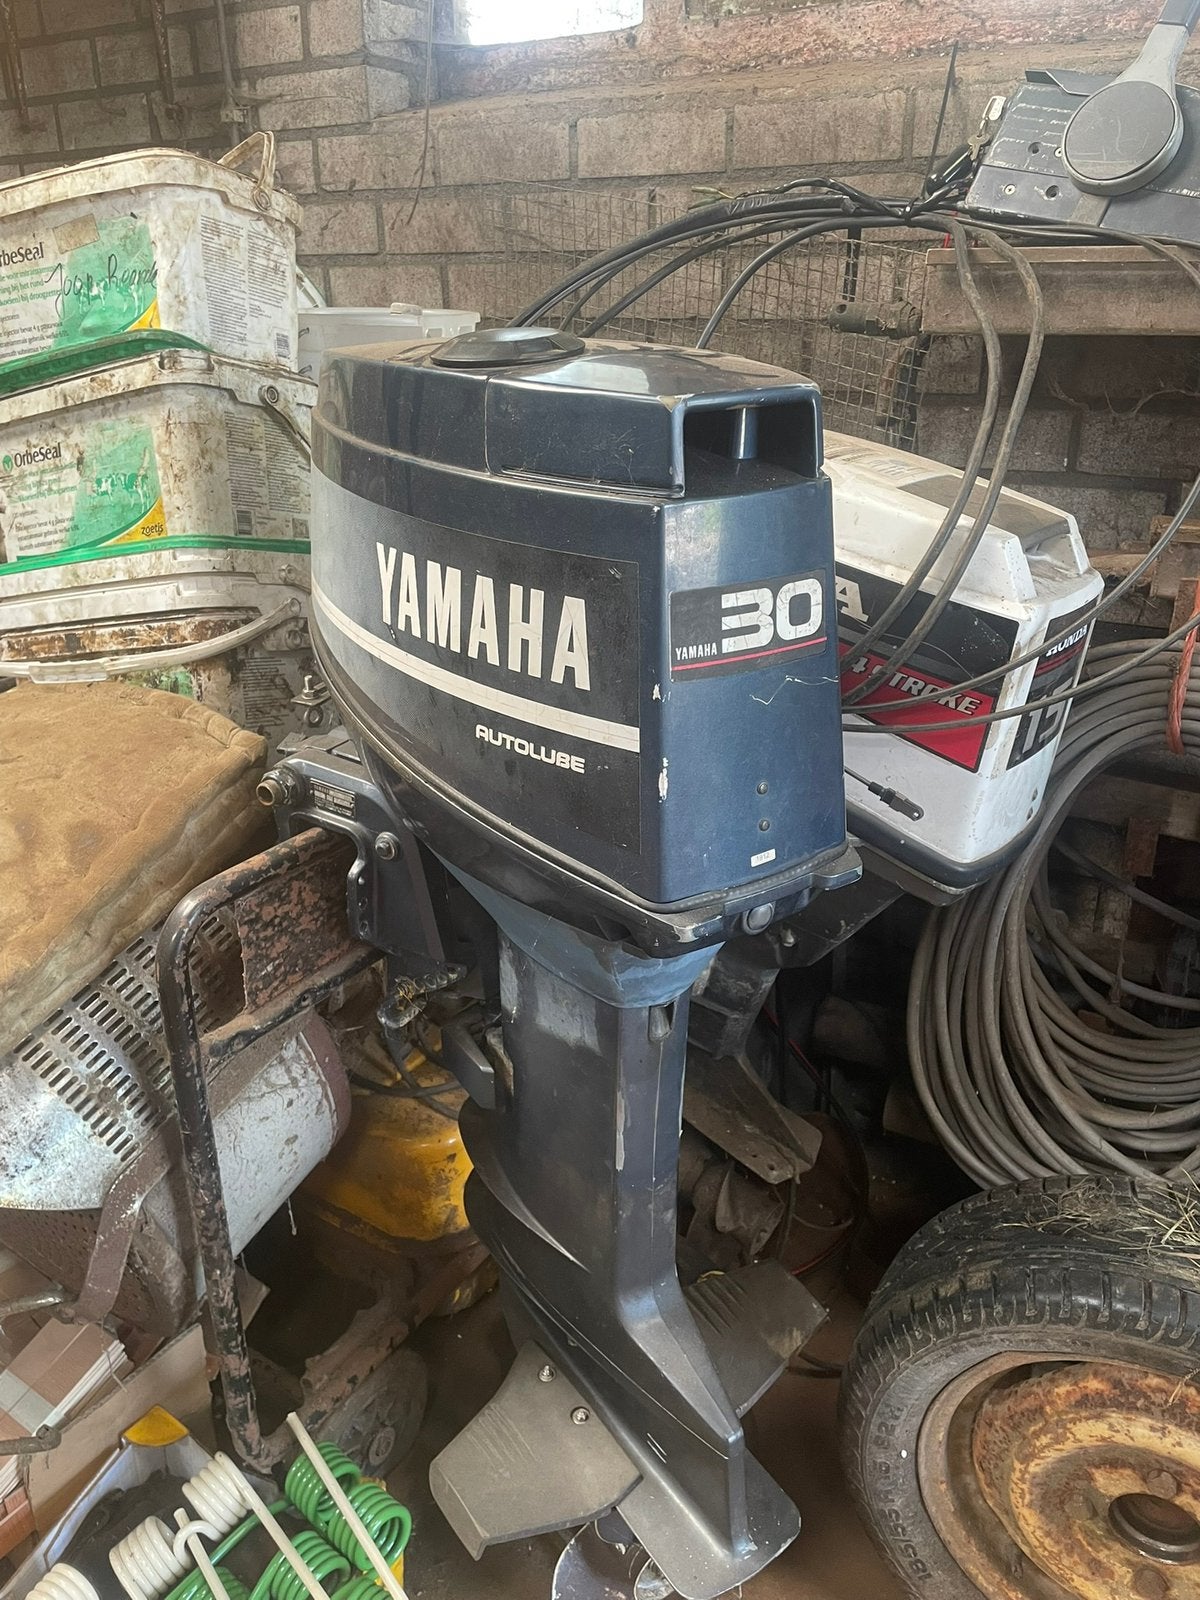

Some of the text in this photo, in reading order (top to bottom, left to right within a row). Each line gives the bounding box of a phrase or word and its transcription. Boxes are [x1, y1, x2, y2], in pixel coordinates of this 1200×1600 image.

[0, 240, 44, 267] rbeSeal
[14, 441, 62, 468] OrbeSeal
[141, 522, 164, 537] zoetis
[376, 541, 591, 692] YAMAHA
[722, 578, 823, 654] 30
[675, 642, 718, 661] YAMAHA
[852, 656, 870, 675] 4
[1022, 676, 1074, 754] 15
[475, 723, 587, 775] AUTOLUBE
